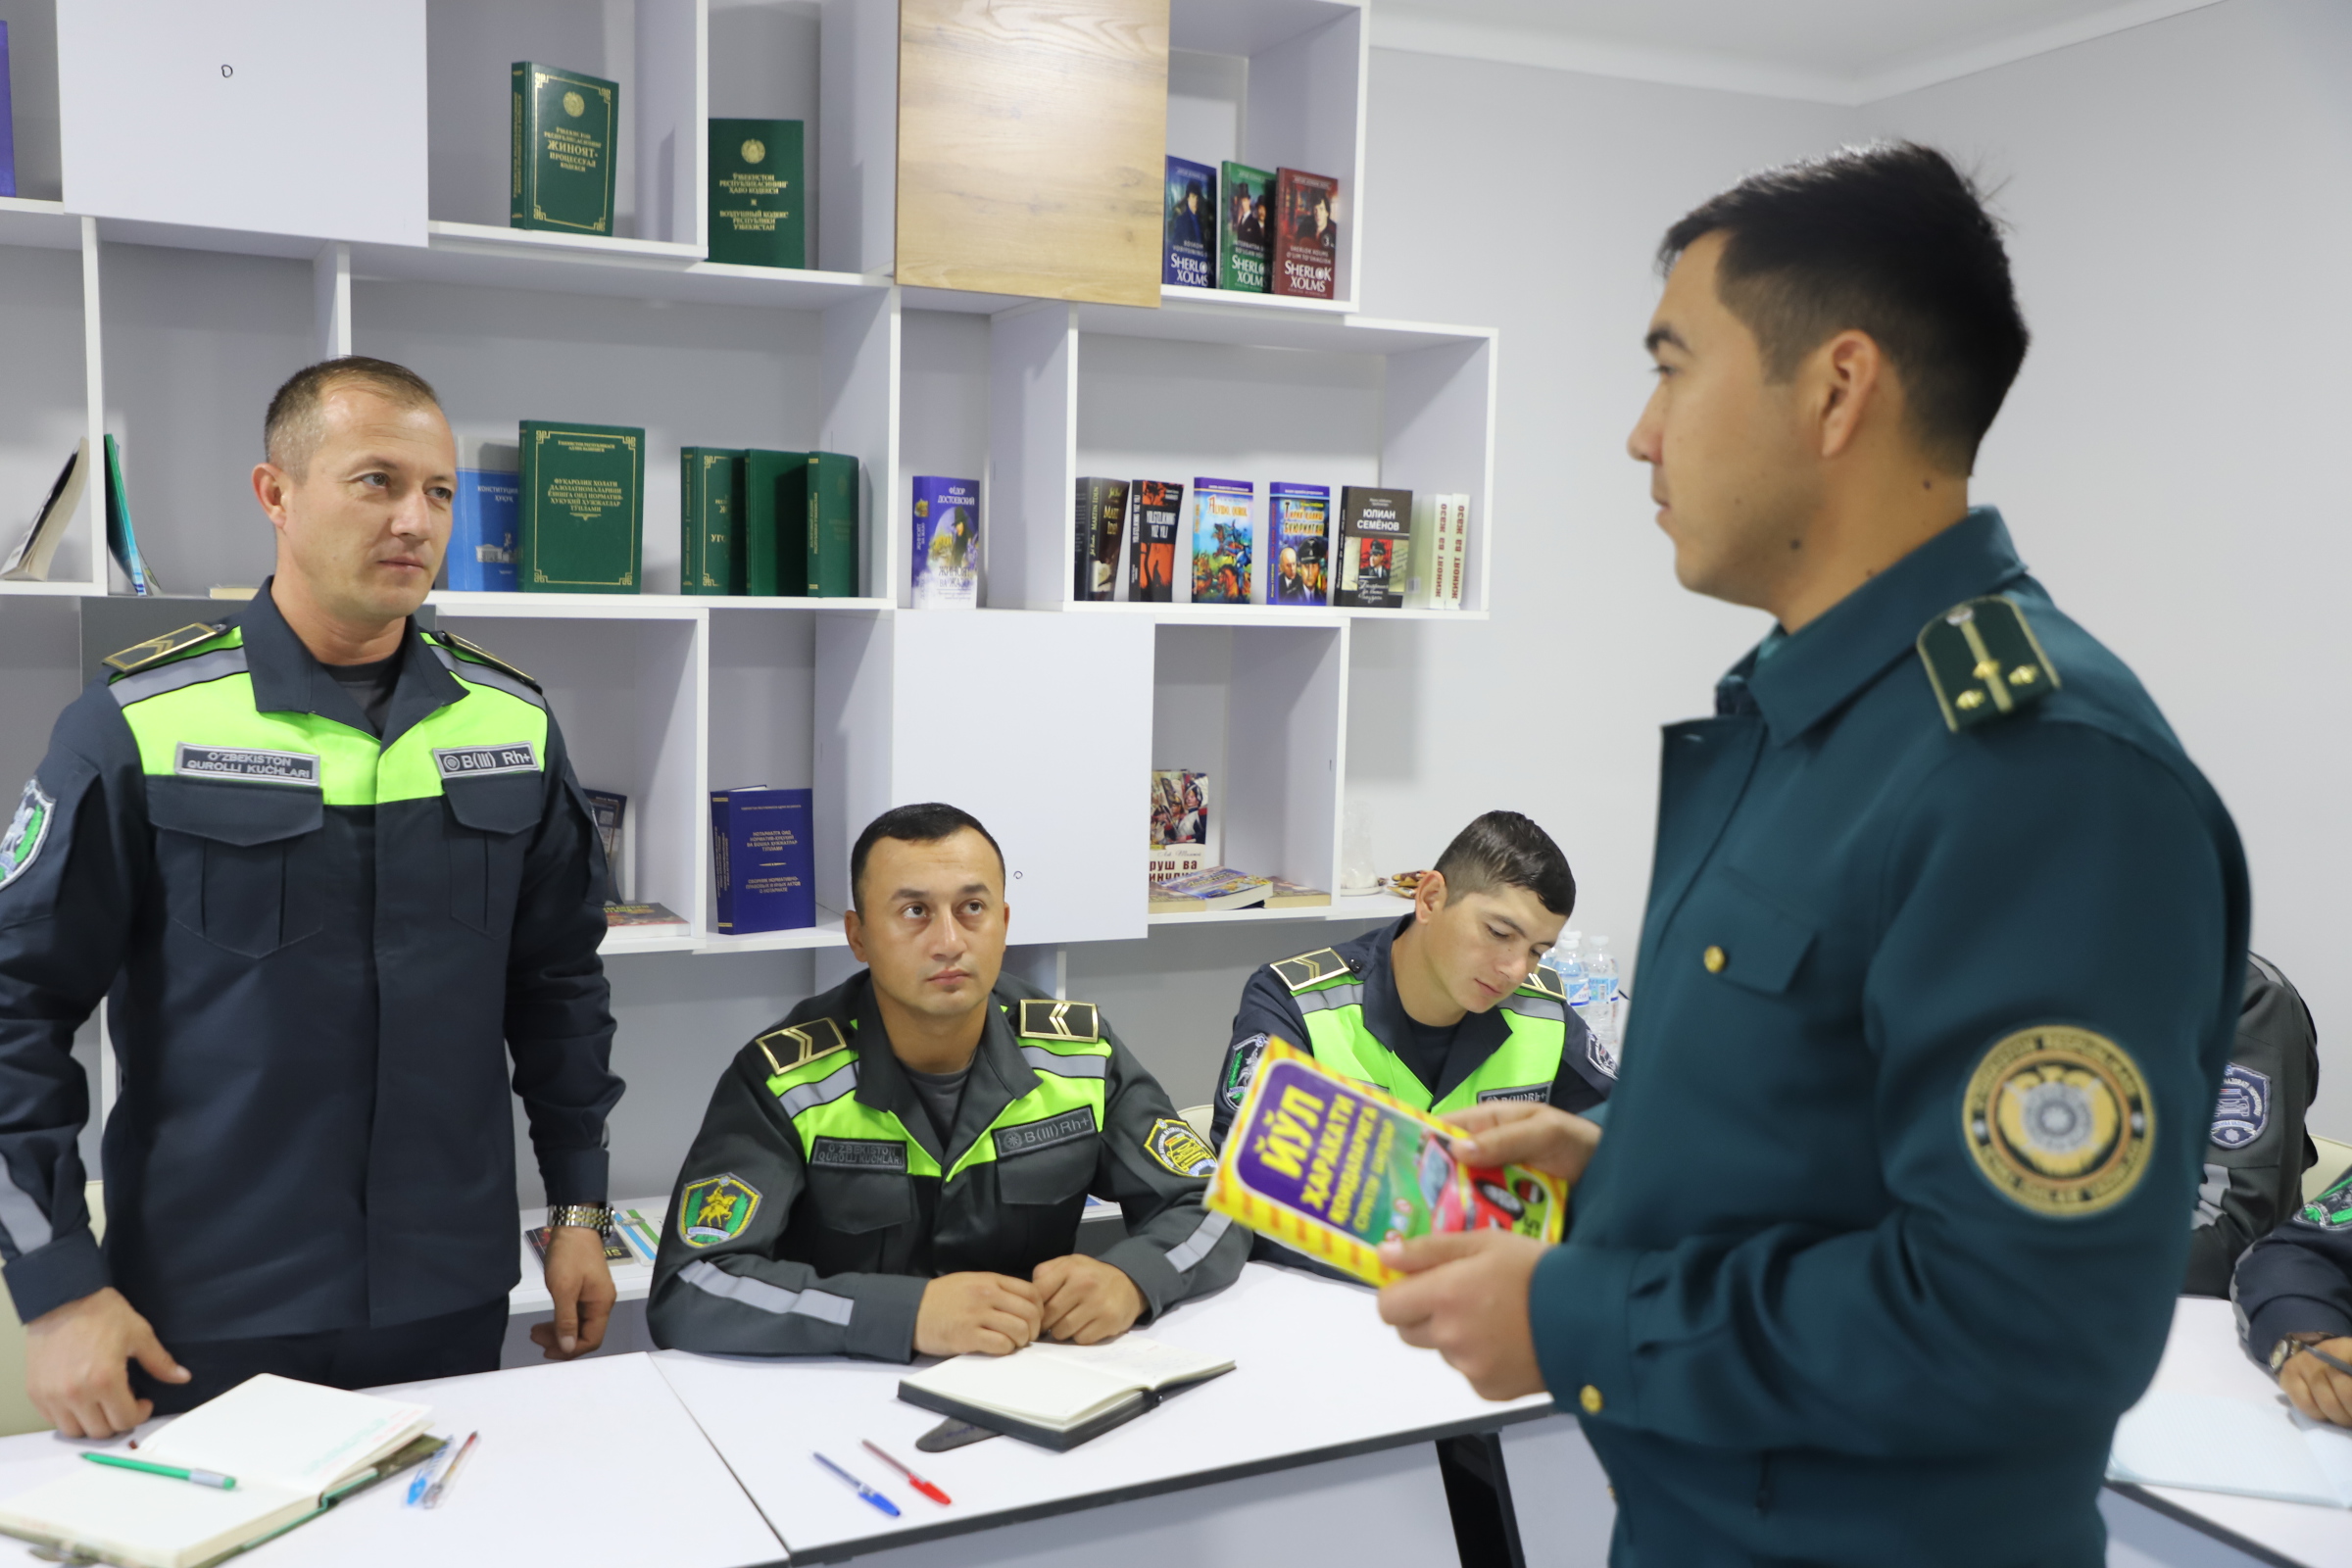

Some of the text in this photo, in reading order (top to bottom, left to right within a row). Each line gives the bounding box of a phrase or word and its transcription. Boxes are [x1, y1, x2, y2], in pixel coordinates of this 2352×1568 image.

[548, 139, 599, 158] ЖИНОЯТ-
[550, 151, 596, 168] ПРОЦЕССУАЛ
[1177, 270, 1208, 287] XOLMS
[1285, 261, 1332, 281] SHERLOK
[1291, 276, 1326, 293] XOLMS
[938, 495, 975, 506] ДОСТОЕВСКИЙ
[1363, 509, 1396, 519] ЮЛИАН
[1357, 519, 1399, 531] СЕМЁНОВ
[207, 752, 291, 766] O'ZBEKISTON
[461, 751, 531, 769] B(III) Rh+
[187, 760, 310, 778] QUROLLI KUCHLARI
[1150, 860, 1198, 871] руш ва
[1253, 1084, 1325, 1180] ЙЎЛ
[818, 1152, 902, 1164] QUROLLI KUCHLARI
[1300, 1093, 1356, 1211] ҲАРАКАТИ
